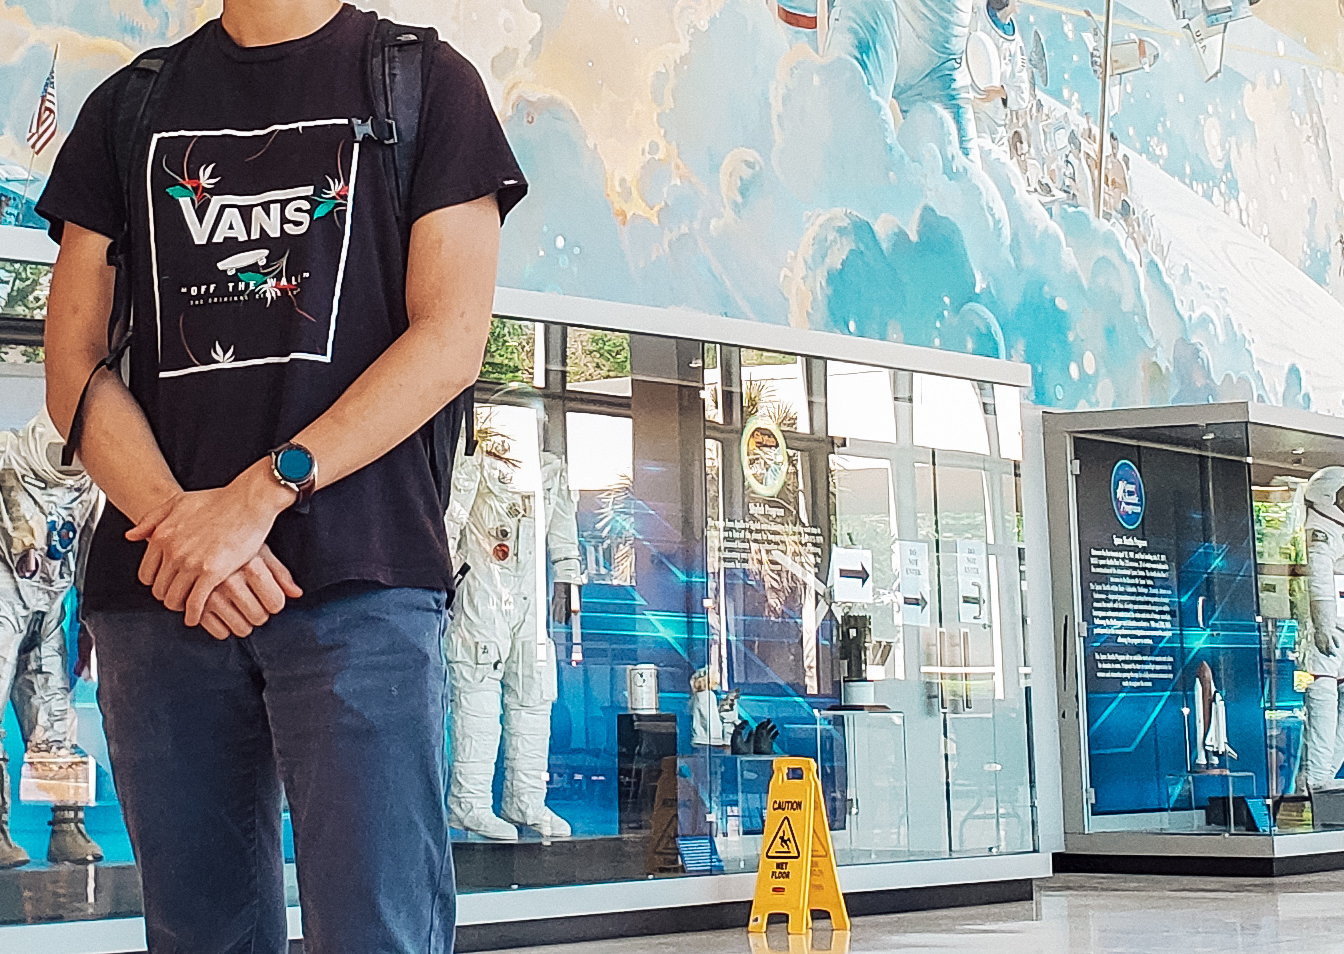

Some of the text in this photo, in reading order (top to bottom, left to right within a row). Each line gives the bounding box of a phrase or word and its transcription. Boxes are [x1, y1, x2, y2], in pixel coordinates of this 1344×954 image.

[178, 185, 315, 245] VANS
[228, 281, 256, 293] THE
[772, 799, 803, 812] CAUTION
[771, 871, 790, 880] FLOOR
